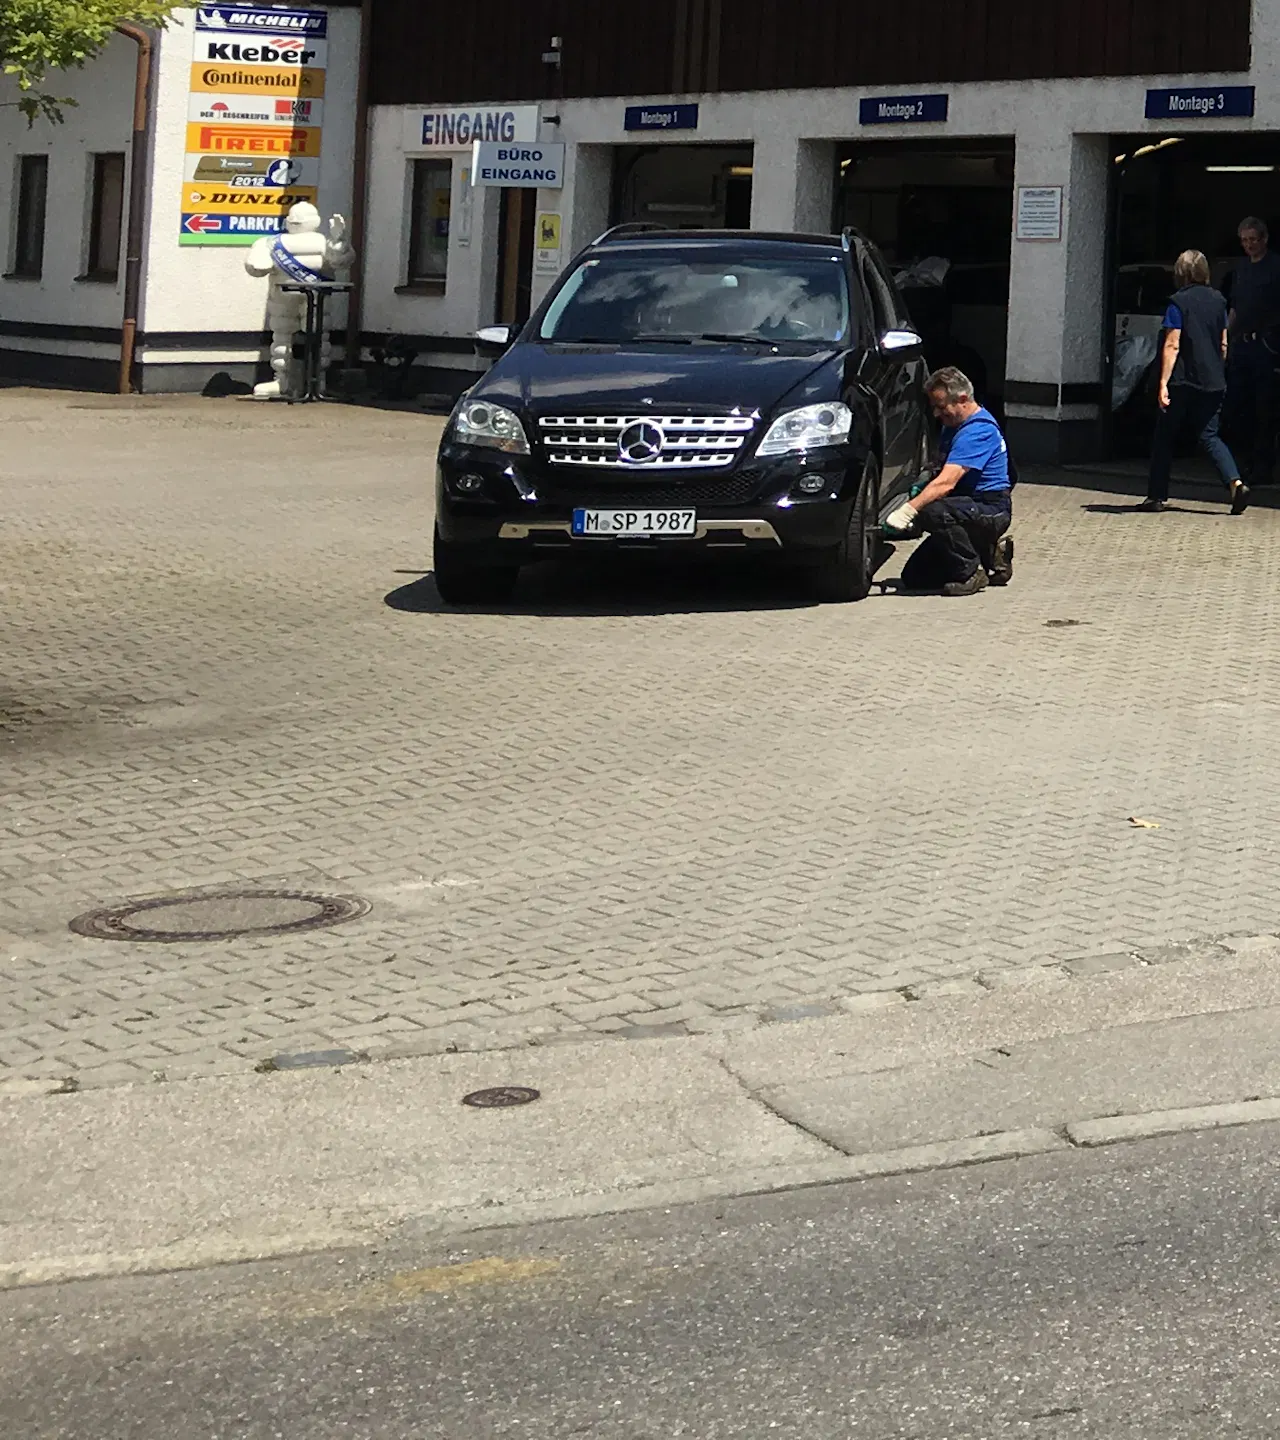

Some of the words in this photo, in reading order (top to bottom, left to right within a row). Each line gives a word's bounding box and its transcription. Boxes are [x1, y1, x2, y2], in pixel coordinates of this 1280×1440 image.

[229, 13, 321, 29] MICHELIN
[208, 42, 316, 64] Kleber
[202, 69, 297, 87] Continental
[878, 102, 915, 120] Montage
[916, 101, 923, 116] 2
[1169, 97, 1215, 114] Montage
[1217, 94, 1225, 110] 3
[641, 111, 672, 126] Montage
[673, 111, 678, 123] 1
[421, 112, 515, 146] EINGANG
[200, 126, 307, 153] PIRELLI
[497, 147, 543, 162] BÜRO
[234, 176, 266, 187] 2012
[481, 168, 557, 181] EINGANG
[586, 512, 599, 530] M
[612, 512, 638, 530] SP
[642, 512, 693, 530] 1987
